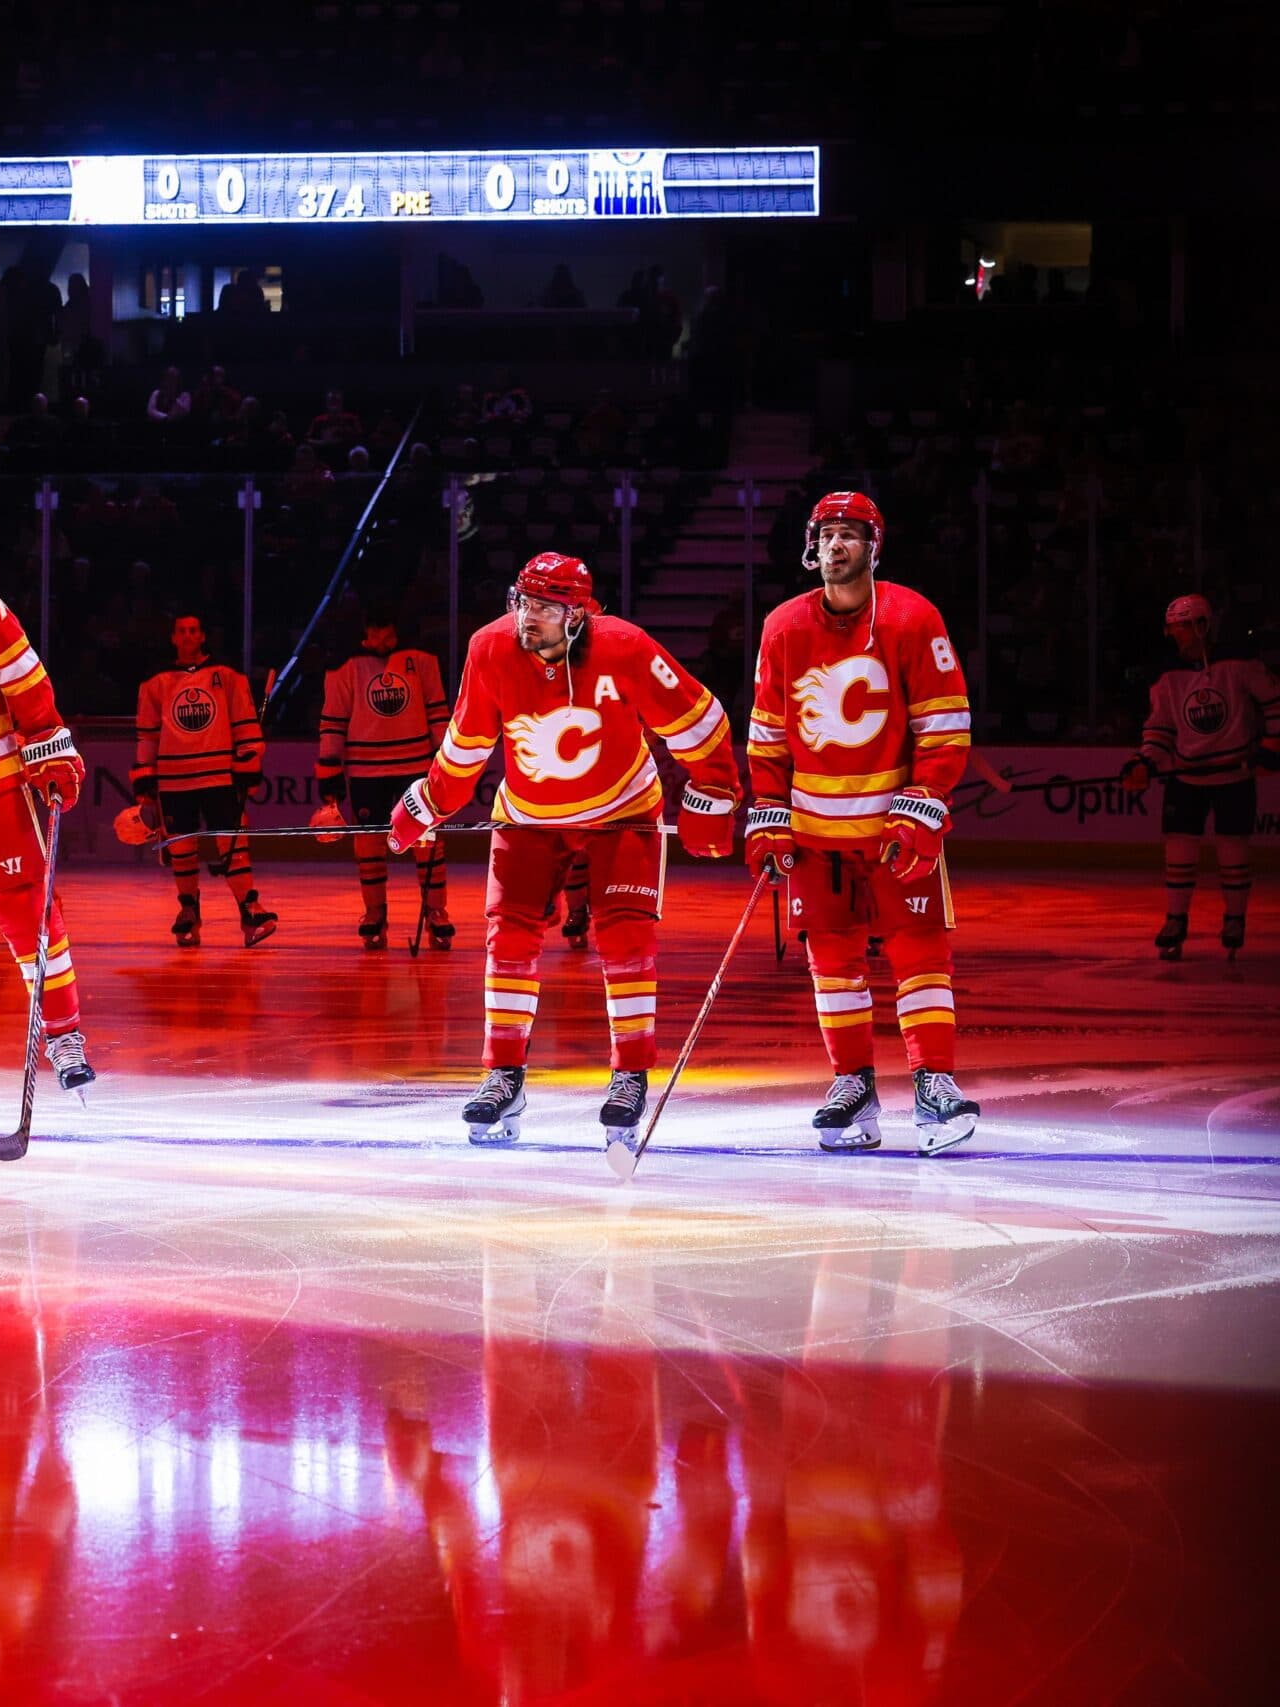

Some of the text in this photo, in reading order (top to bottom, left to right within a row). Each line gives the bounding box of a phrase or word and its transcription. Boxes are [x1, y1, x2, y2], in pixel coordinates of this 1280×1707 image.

[157, 165, 180, 200] 0
[218, 166, 246, 214] 0
[485, 163, 516, 211] 0
[547, 160, 570, 195] 0
[145, 203, 198, 220] SHOTS
[298, 184, 432, 218] 37.4 PRE
[531, 198, 588, 215] SHOTS
[211, 671, 222, 687] A
[594, 675, 621, 708] A
